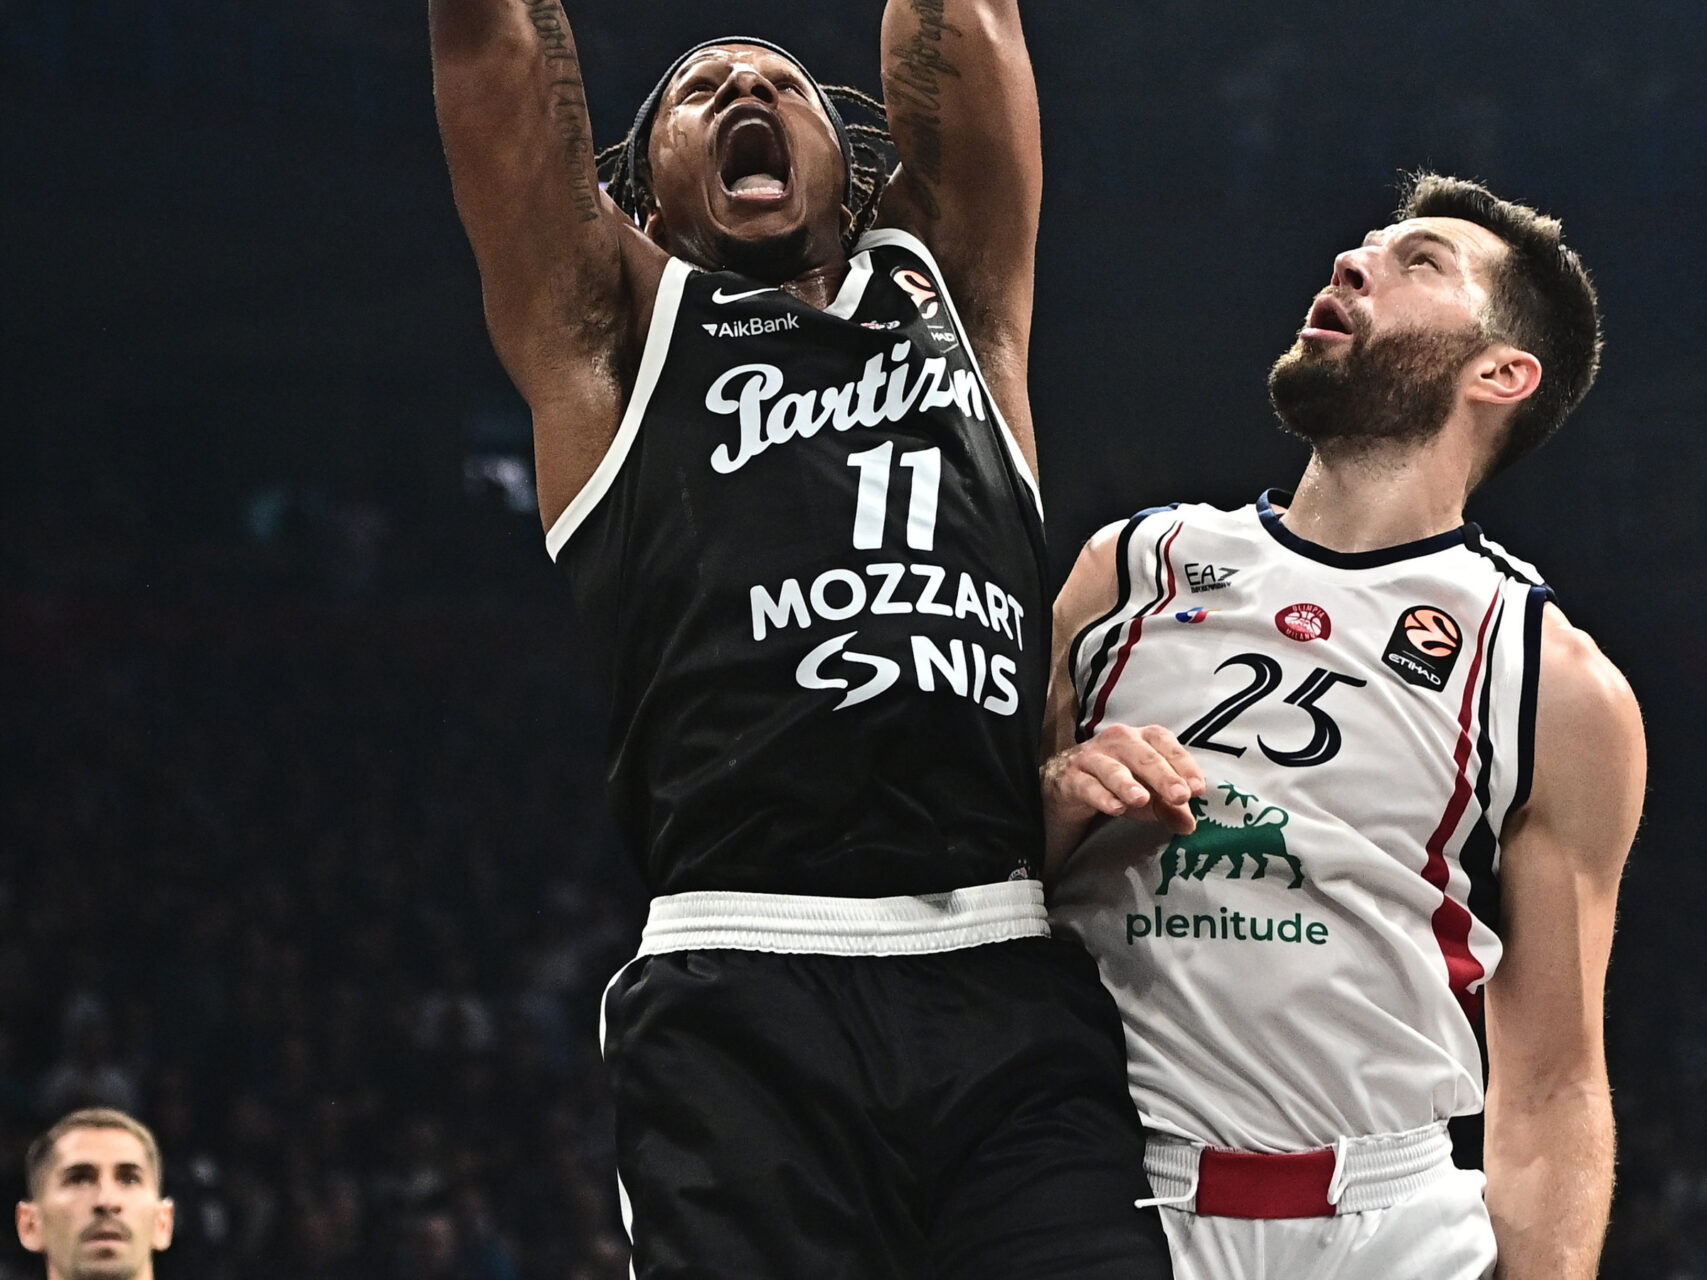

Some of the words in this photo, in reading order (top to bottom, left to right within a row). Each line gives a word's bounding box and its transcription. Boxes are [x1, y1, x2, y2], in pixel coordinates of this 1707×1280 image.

[718, 312, 800, 338] AikBank
[705, 340, 986, 474] Partizn
[846, 440, 942, 552] 11
[749, 563, 1024, 651] MOZZART
[1184, 563, 1240, 586] EA7
[911, 635, 1019, 716] NIS
[1388, 653, 1442, 685] ETIHAD
[1177, 653, 1367, 768] 25
[1126, 906, 1329, 945] plenitude
